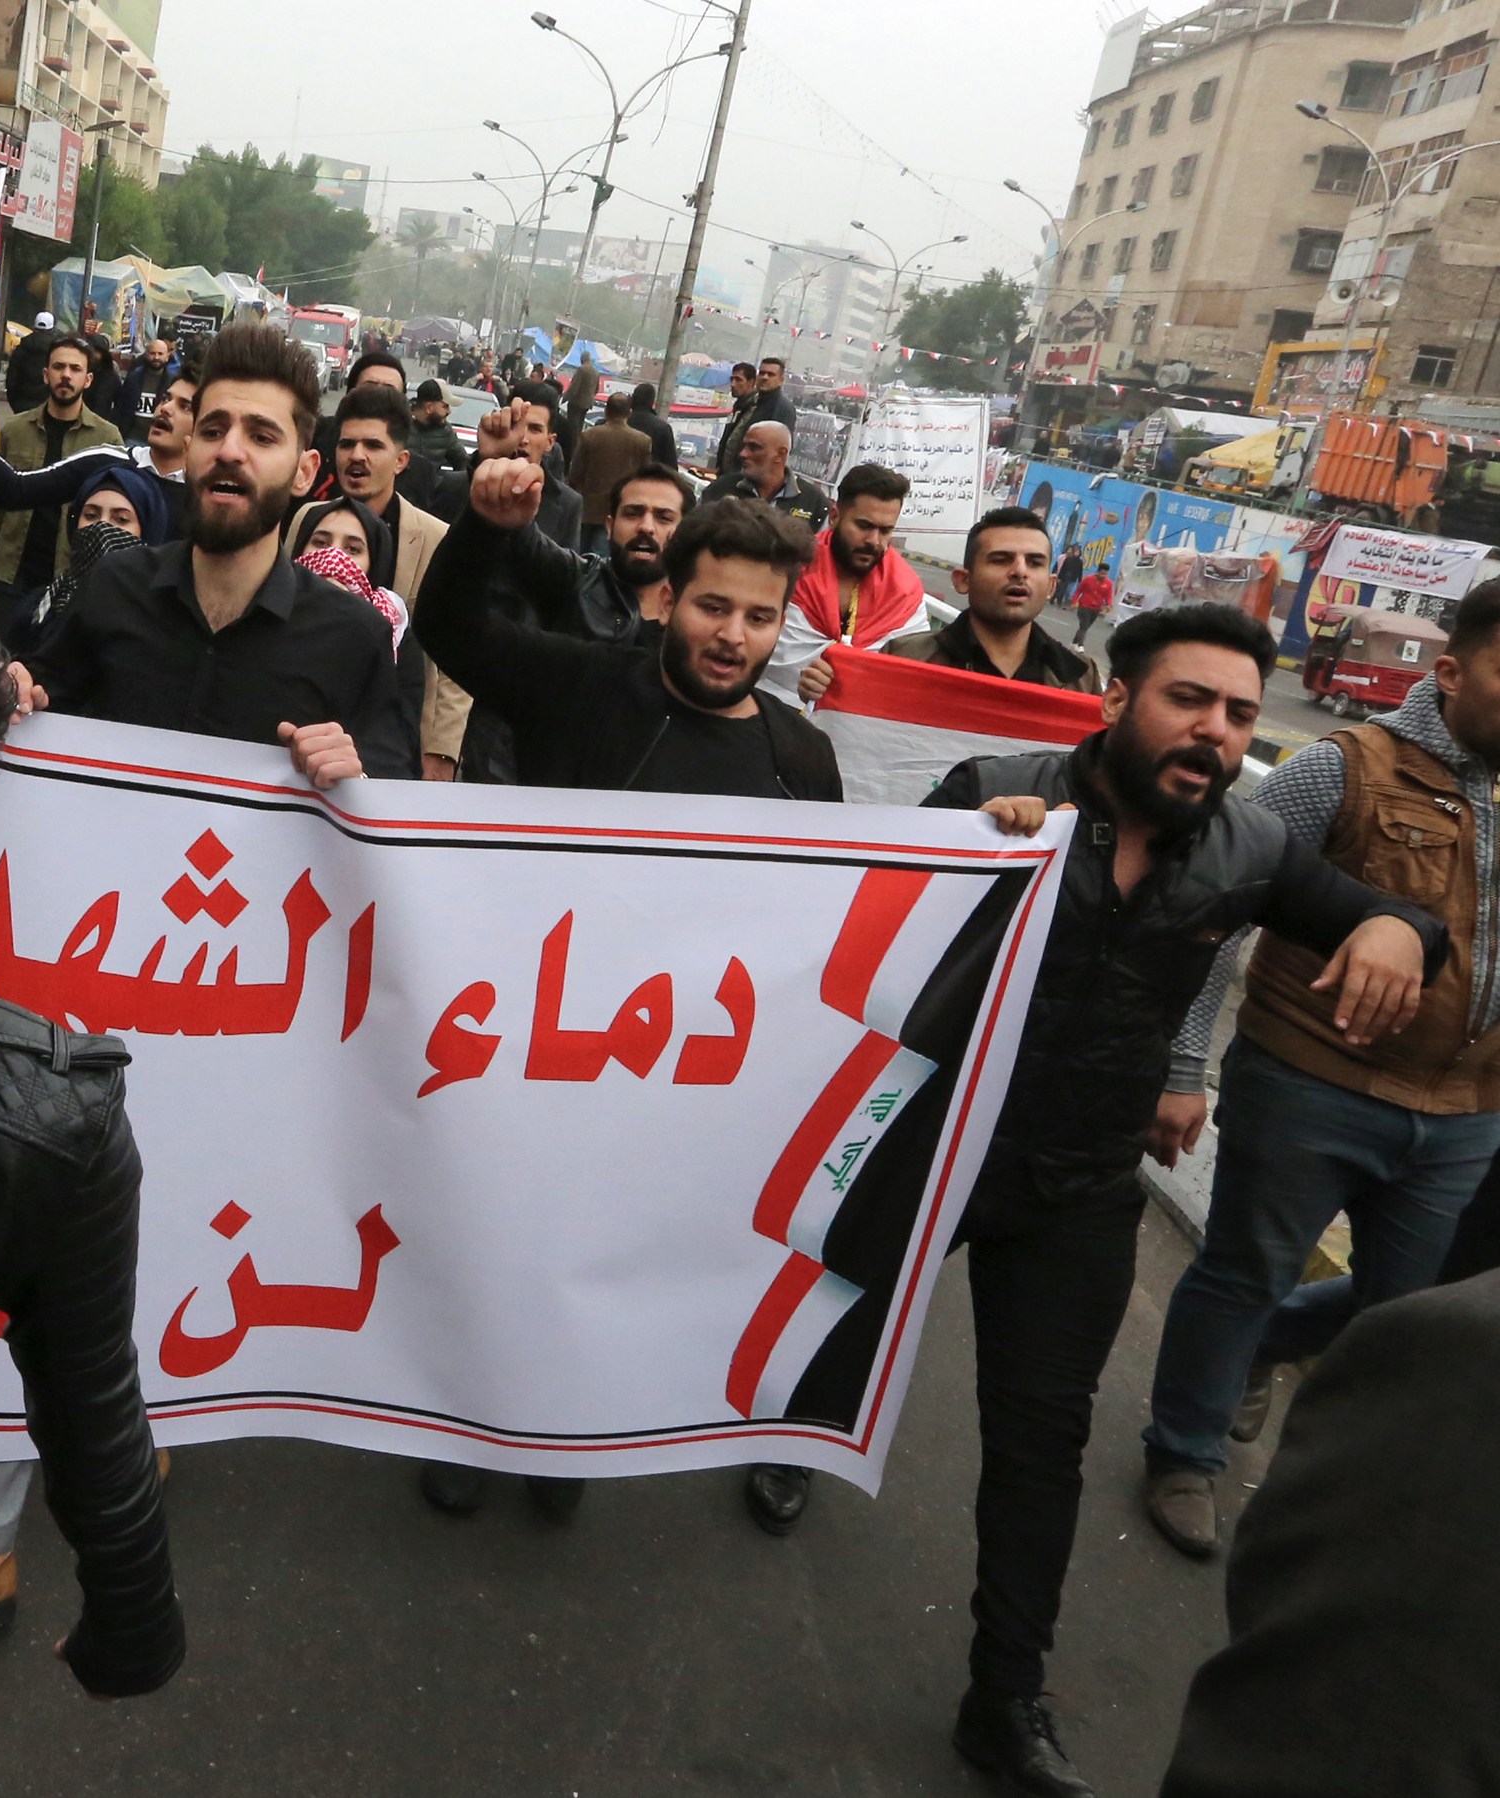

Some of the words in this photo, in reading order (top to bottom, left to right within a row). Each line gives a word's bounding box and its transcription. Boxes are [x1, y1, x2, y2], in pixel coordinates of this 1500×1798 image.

[313, 323, 325, 331] 35
[1083, 535, 1114, 570] STOP
[1418, 555, 1430, 566] لم
[1432, 556, 1444, 567] ما
[1429, 573, 1448, 585] من
[417, 909, 757, 1099] دماء
[158, 1200, 401, 1378] لن
